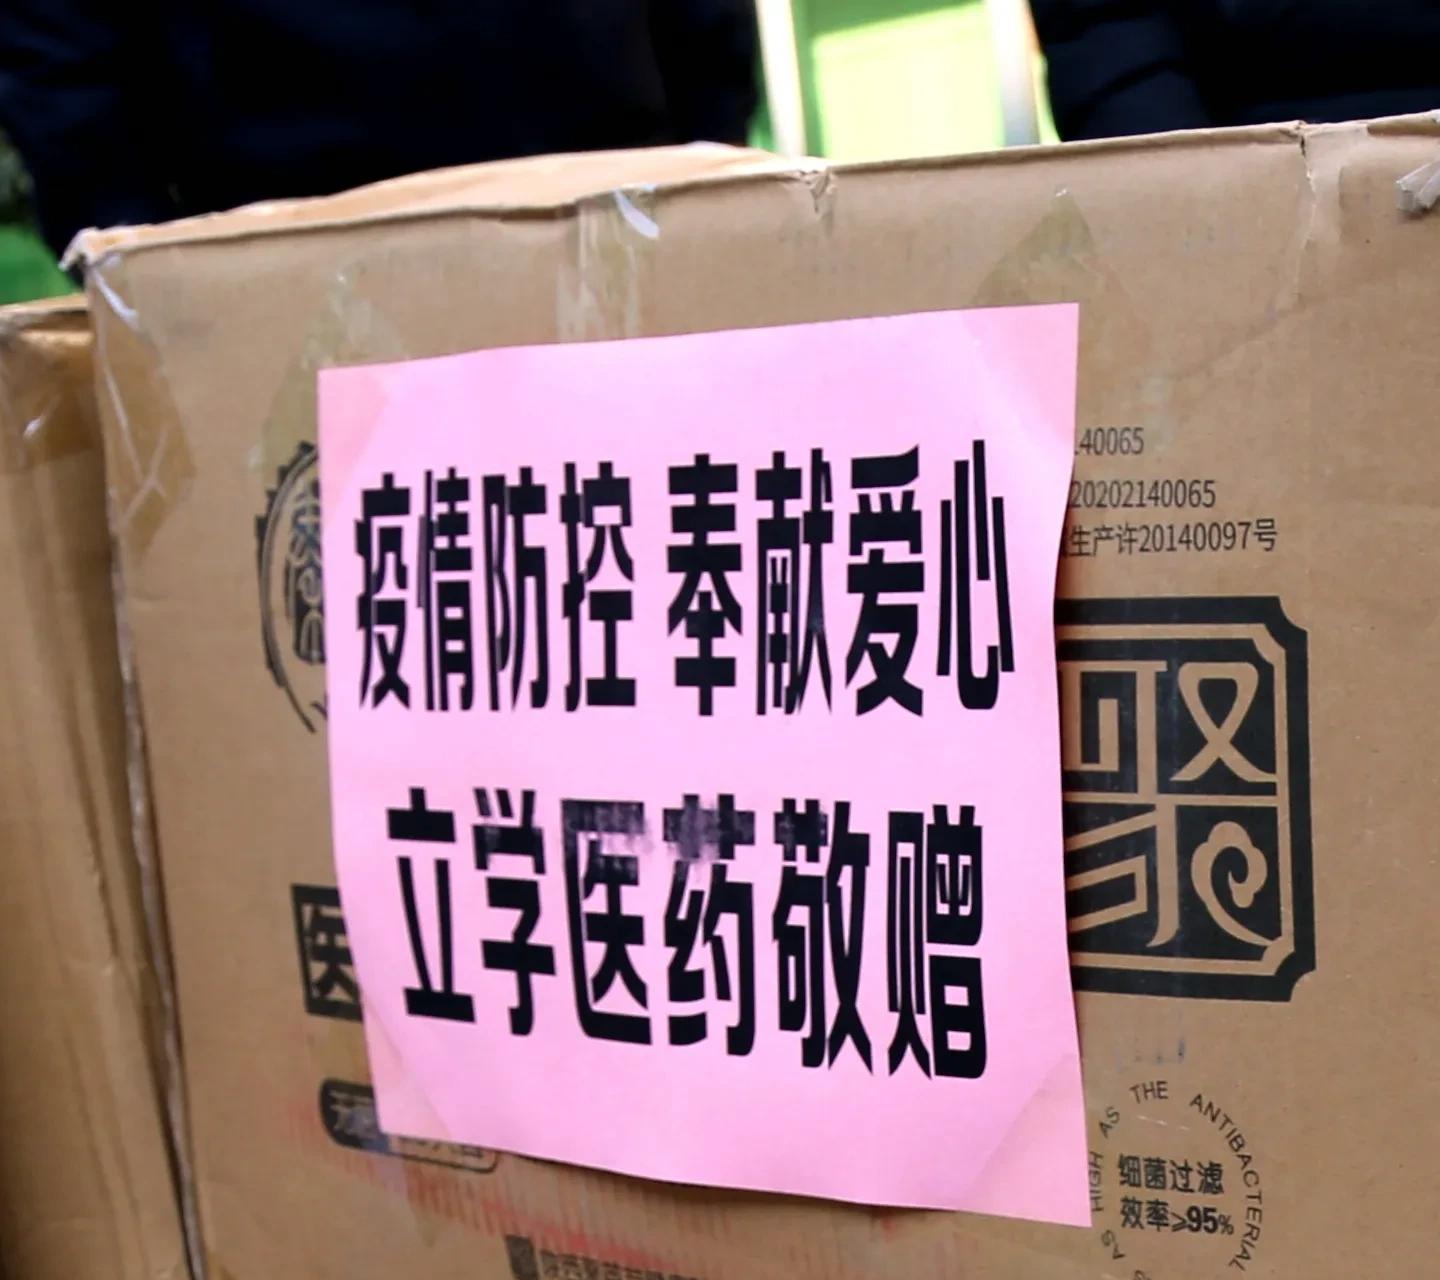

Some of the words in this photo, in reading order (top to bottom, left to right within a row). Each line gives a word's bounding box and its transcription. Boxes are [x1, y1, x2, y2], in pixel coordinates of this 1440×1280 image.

[1074, 427, 1145, 458] 40065
[355, 461, 636, 713] 疫情防控
[667, 438, 1015, 717] 奉献爱心
[386, 784, 988, 1081] 立学医药敬赠
[1098, 1106, 1120, 1139] AS
[1129, 1080, 1168, 1104] THE
[1189, 1093, 1263, 1272] ANTIBACTERIAL
[1117, 1153, 1225, 1195] 细菌过滤
